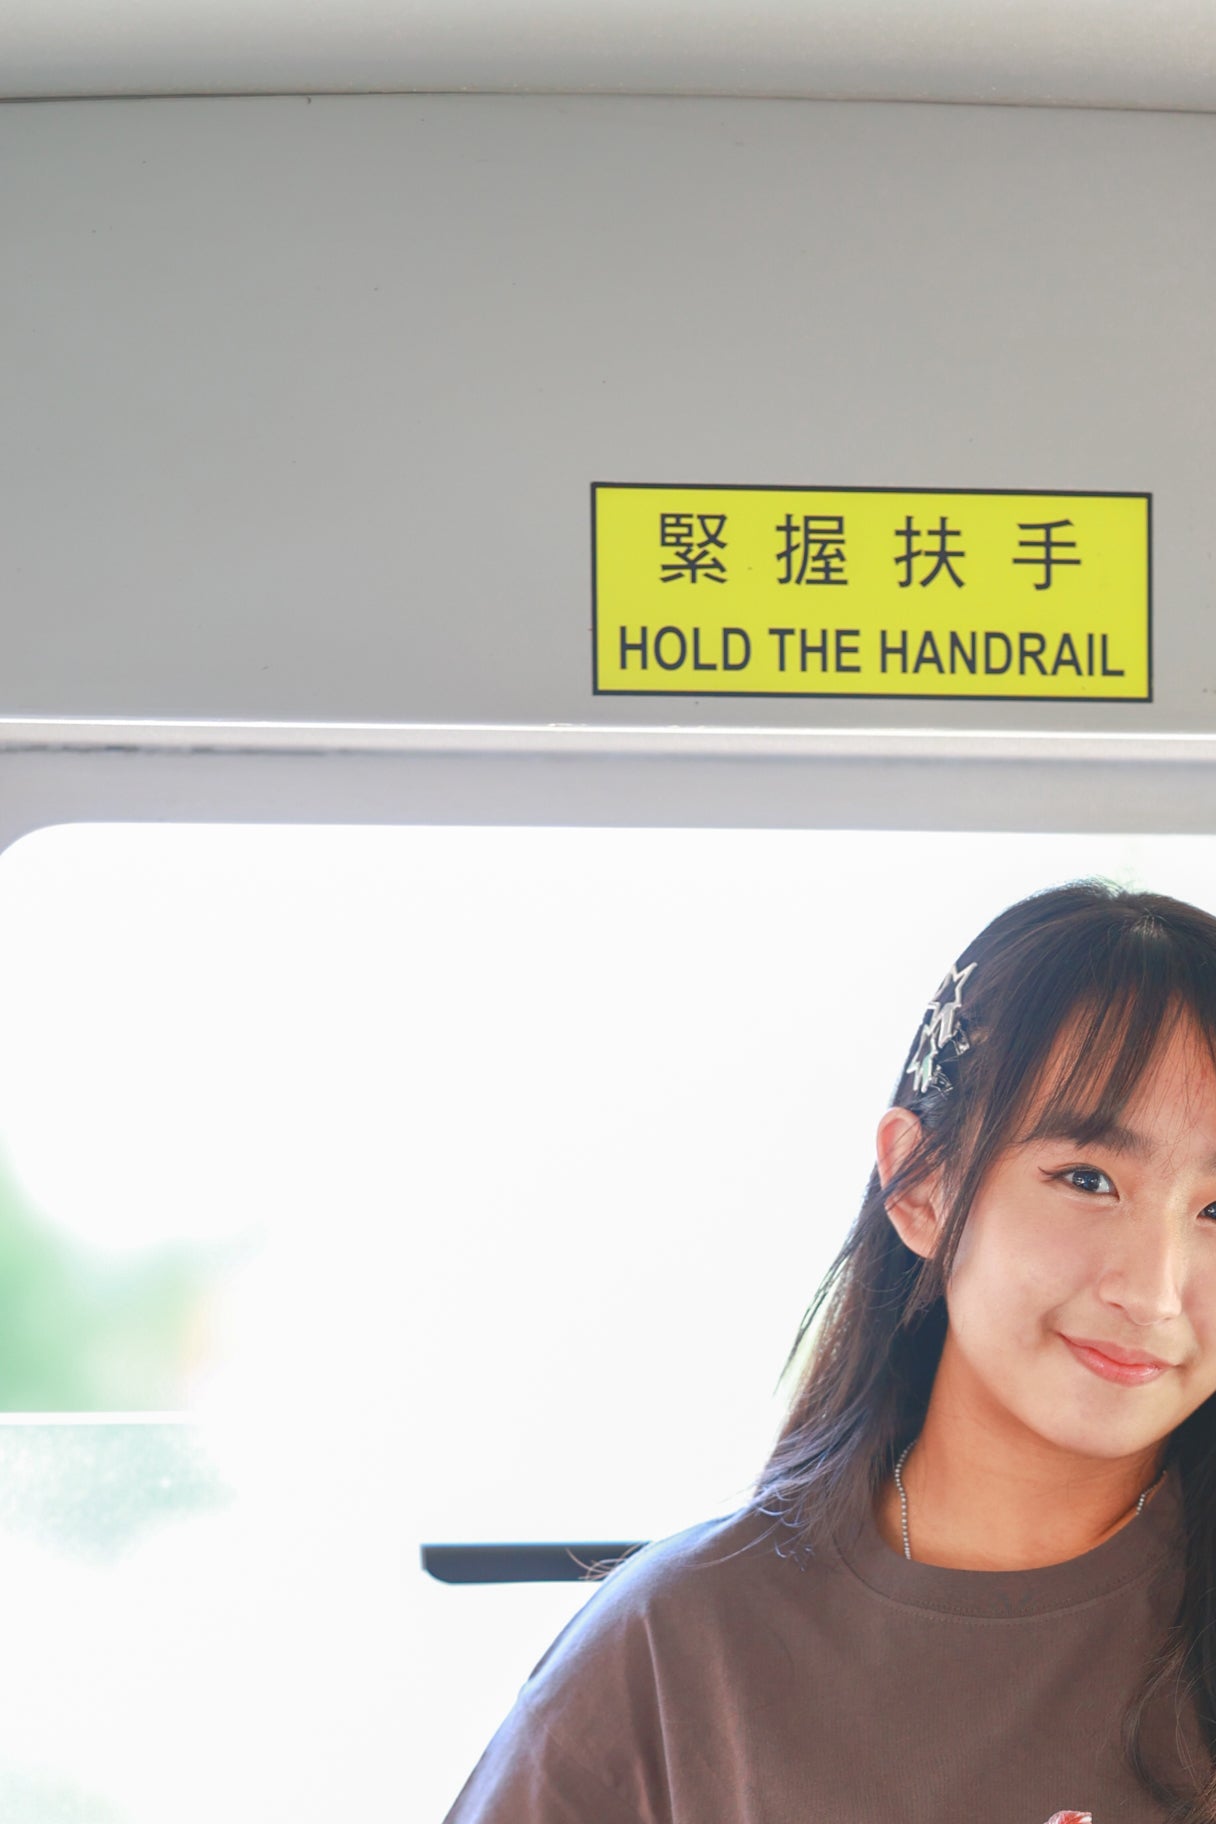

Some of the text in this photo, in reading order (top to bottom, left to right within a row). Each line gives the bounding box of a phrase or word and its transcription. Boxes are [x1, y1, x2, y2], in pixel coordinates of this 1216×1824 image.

[660, 513, 1082, 592] 緊握扶手
[619, 625, 1126, 678] HOLD THE HANDRAIL
